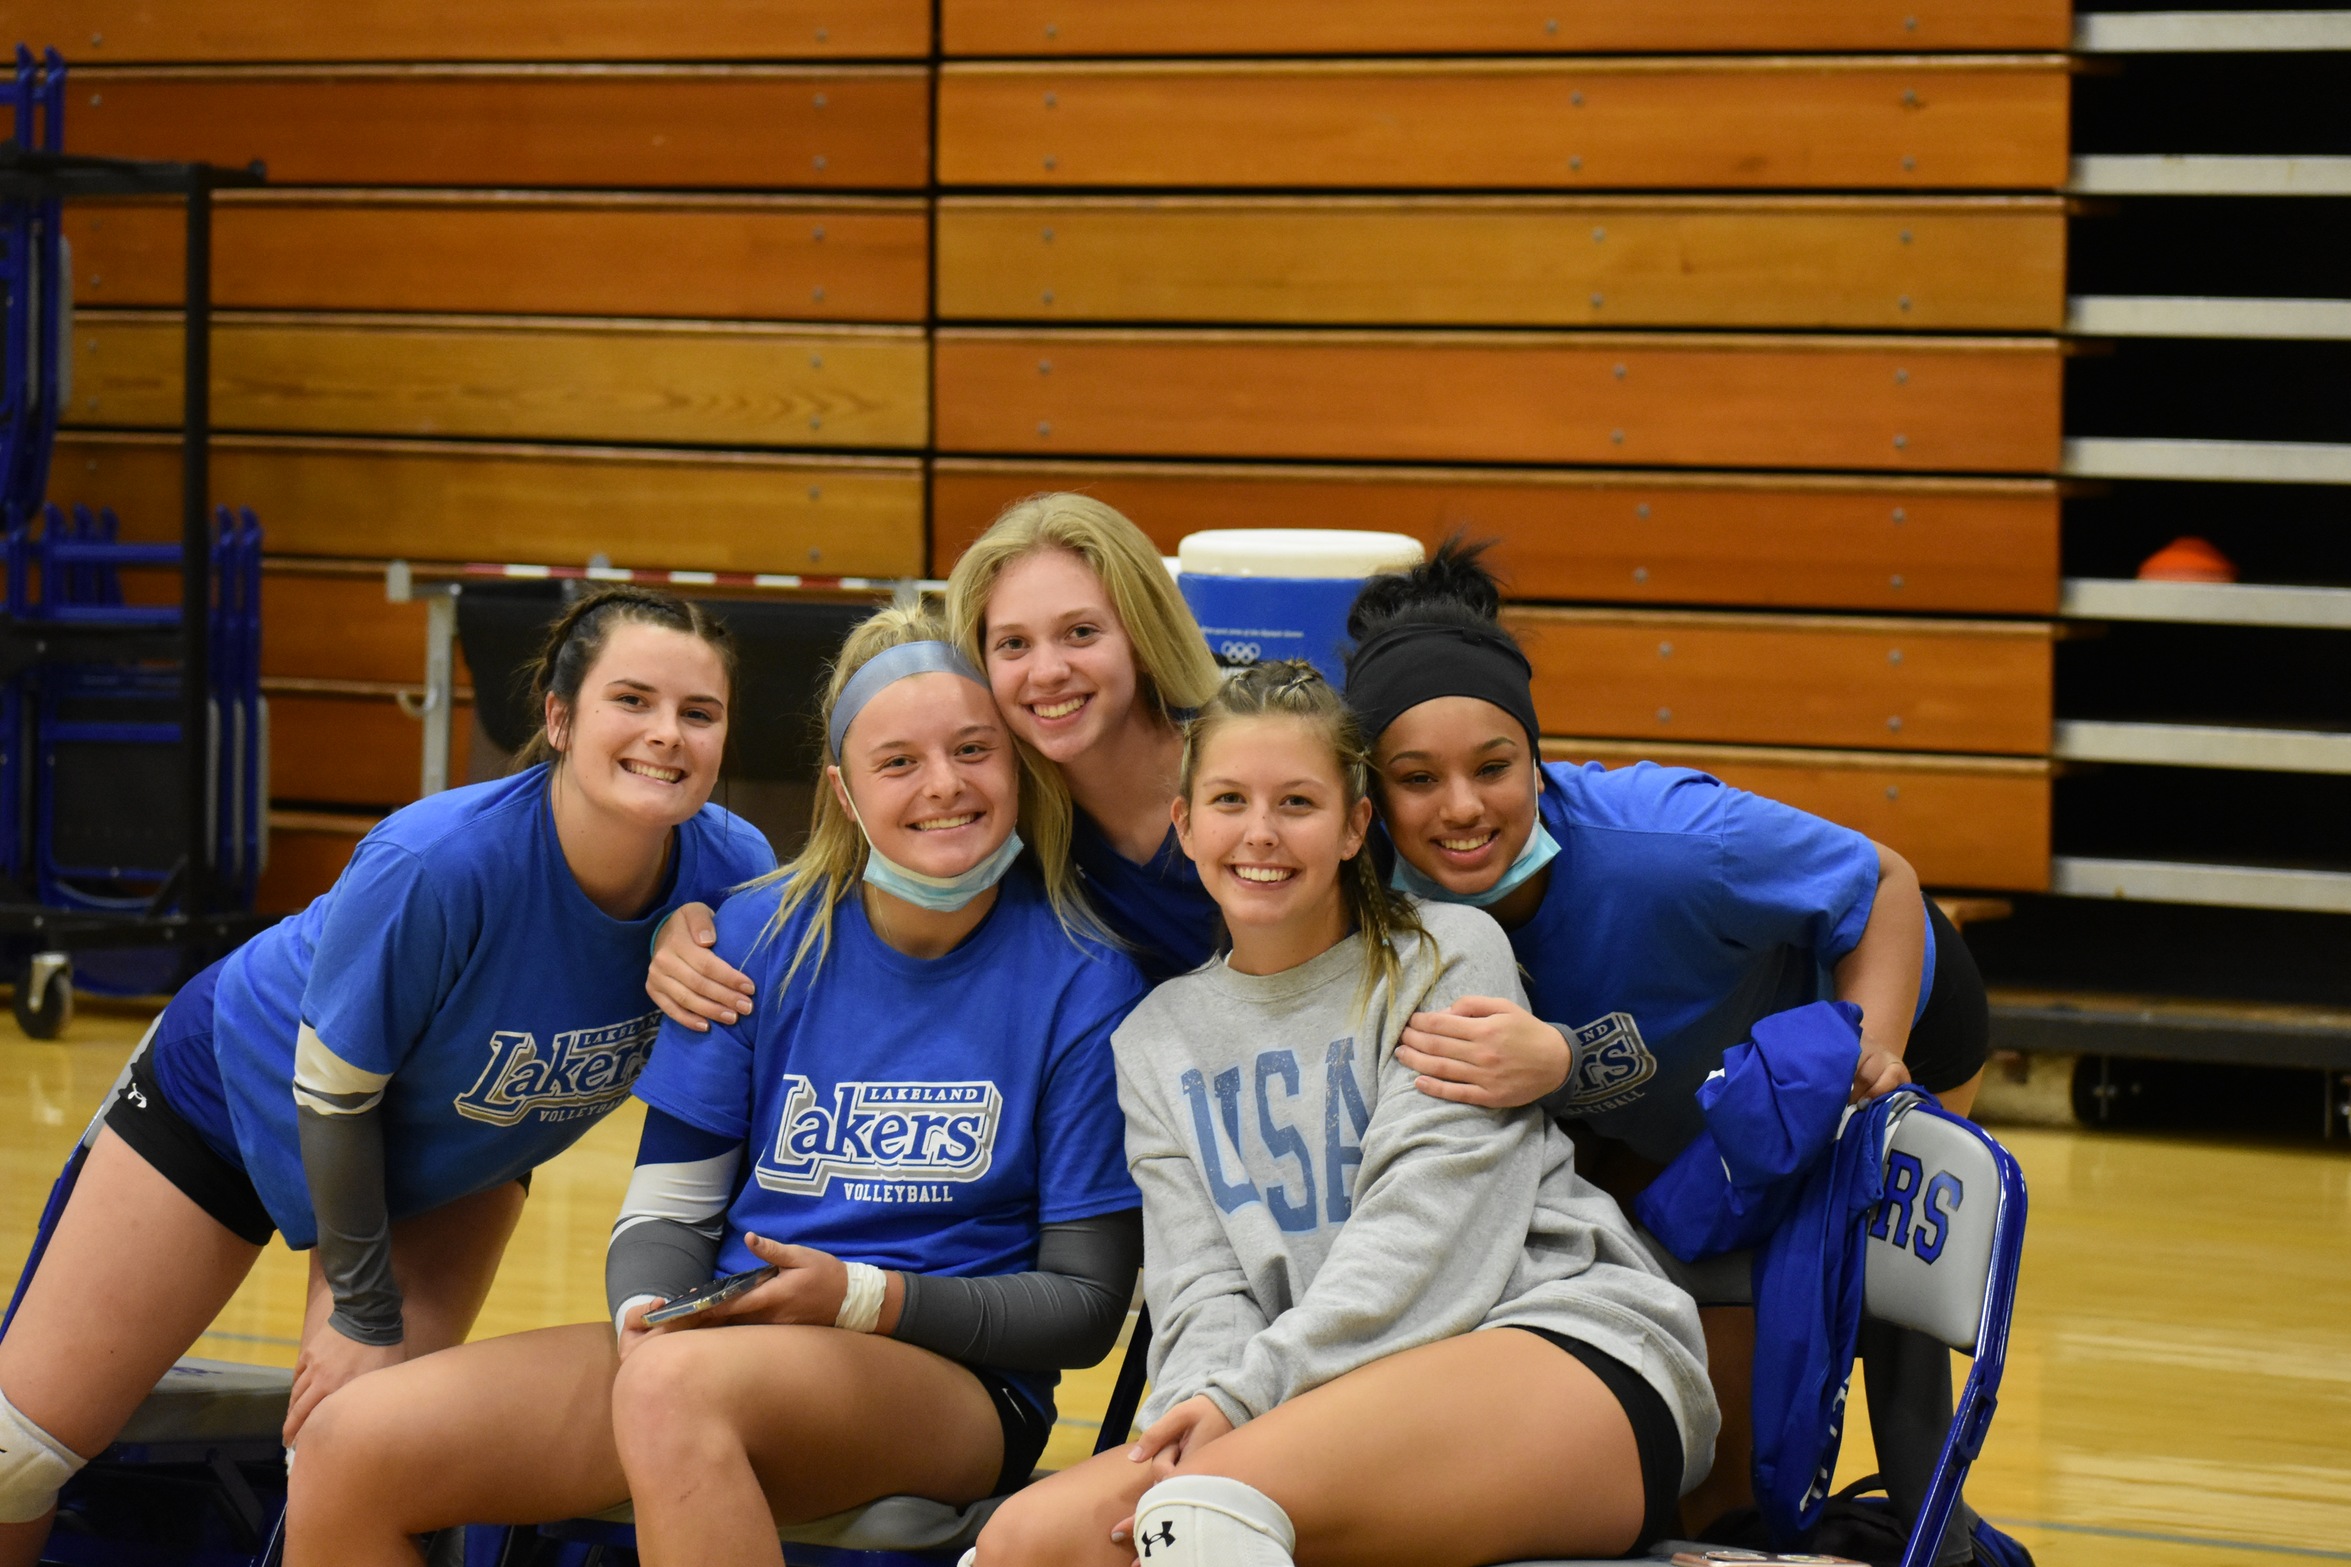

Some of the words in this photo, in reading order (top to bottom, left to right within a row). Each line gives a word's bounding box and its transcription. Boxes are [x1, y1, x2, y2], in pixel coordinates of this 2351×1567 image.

[583, 1015, 661, 1046] LAKELAN
[869, 1088, 979, 1101] LAKELAND
[755, 1074, 999, 1193] Lakers
[1179, 1036, 1371, 1233] USA
[843, 1182, 953, 1203] VOLLEYBALL
